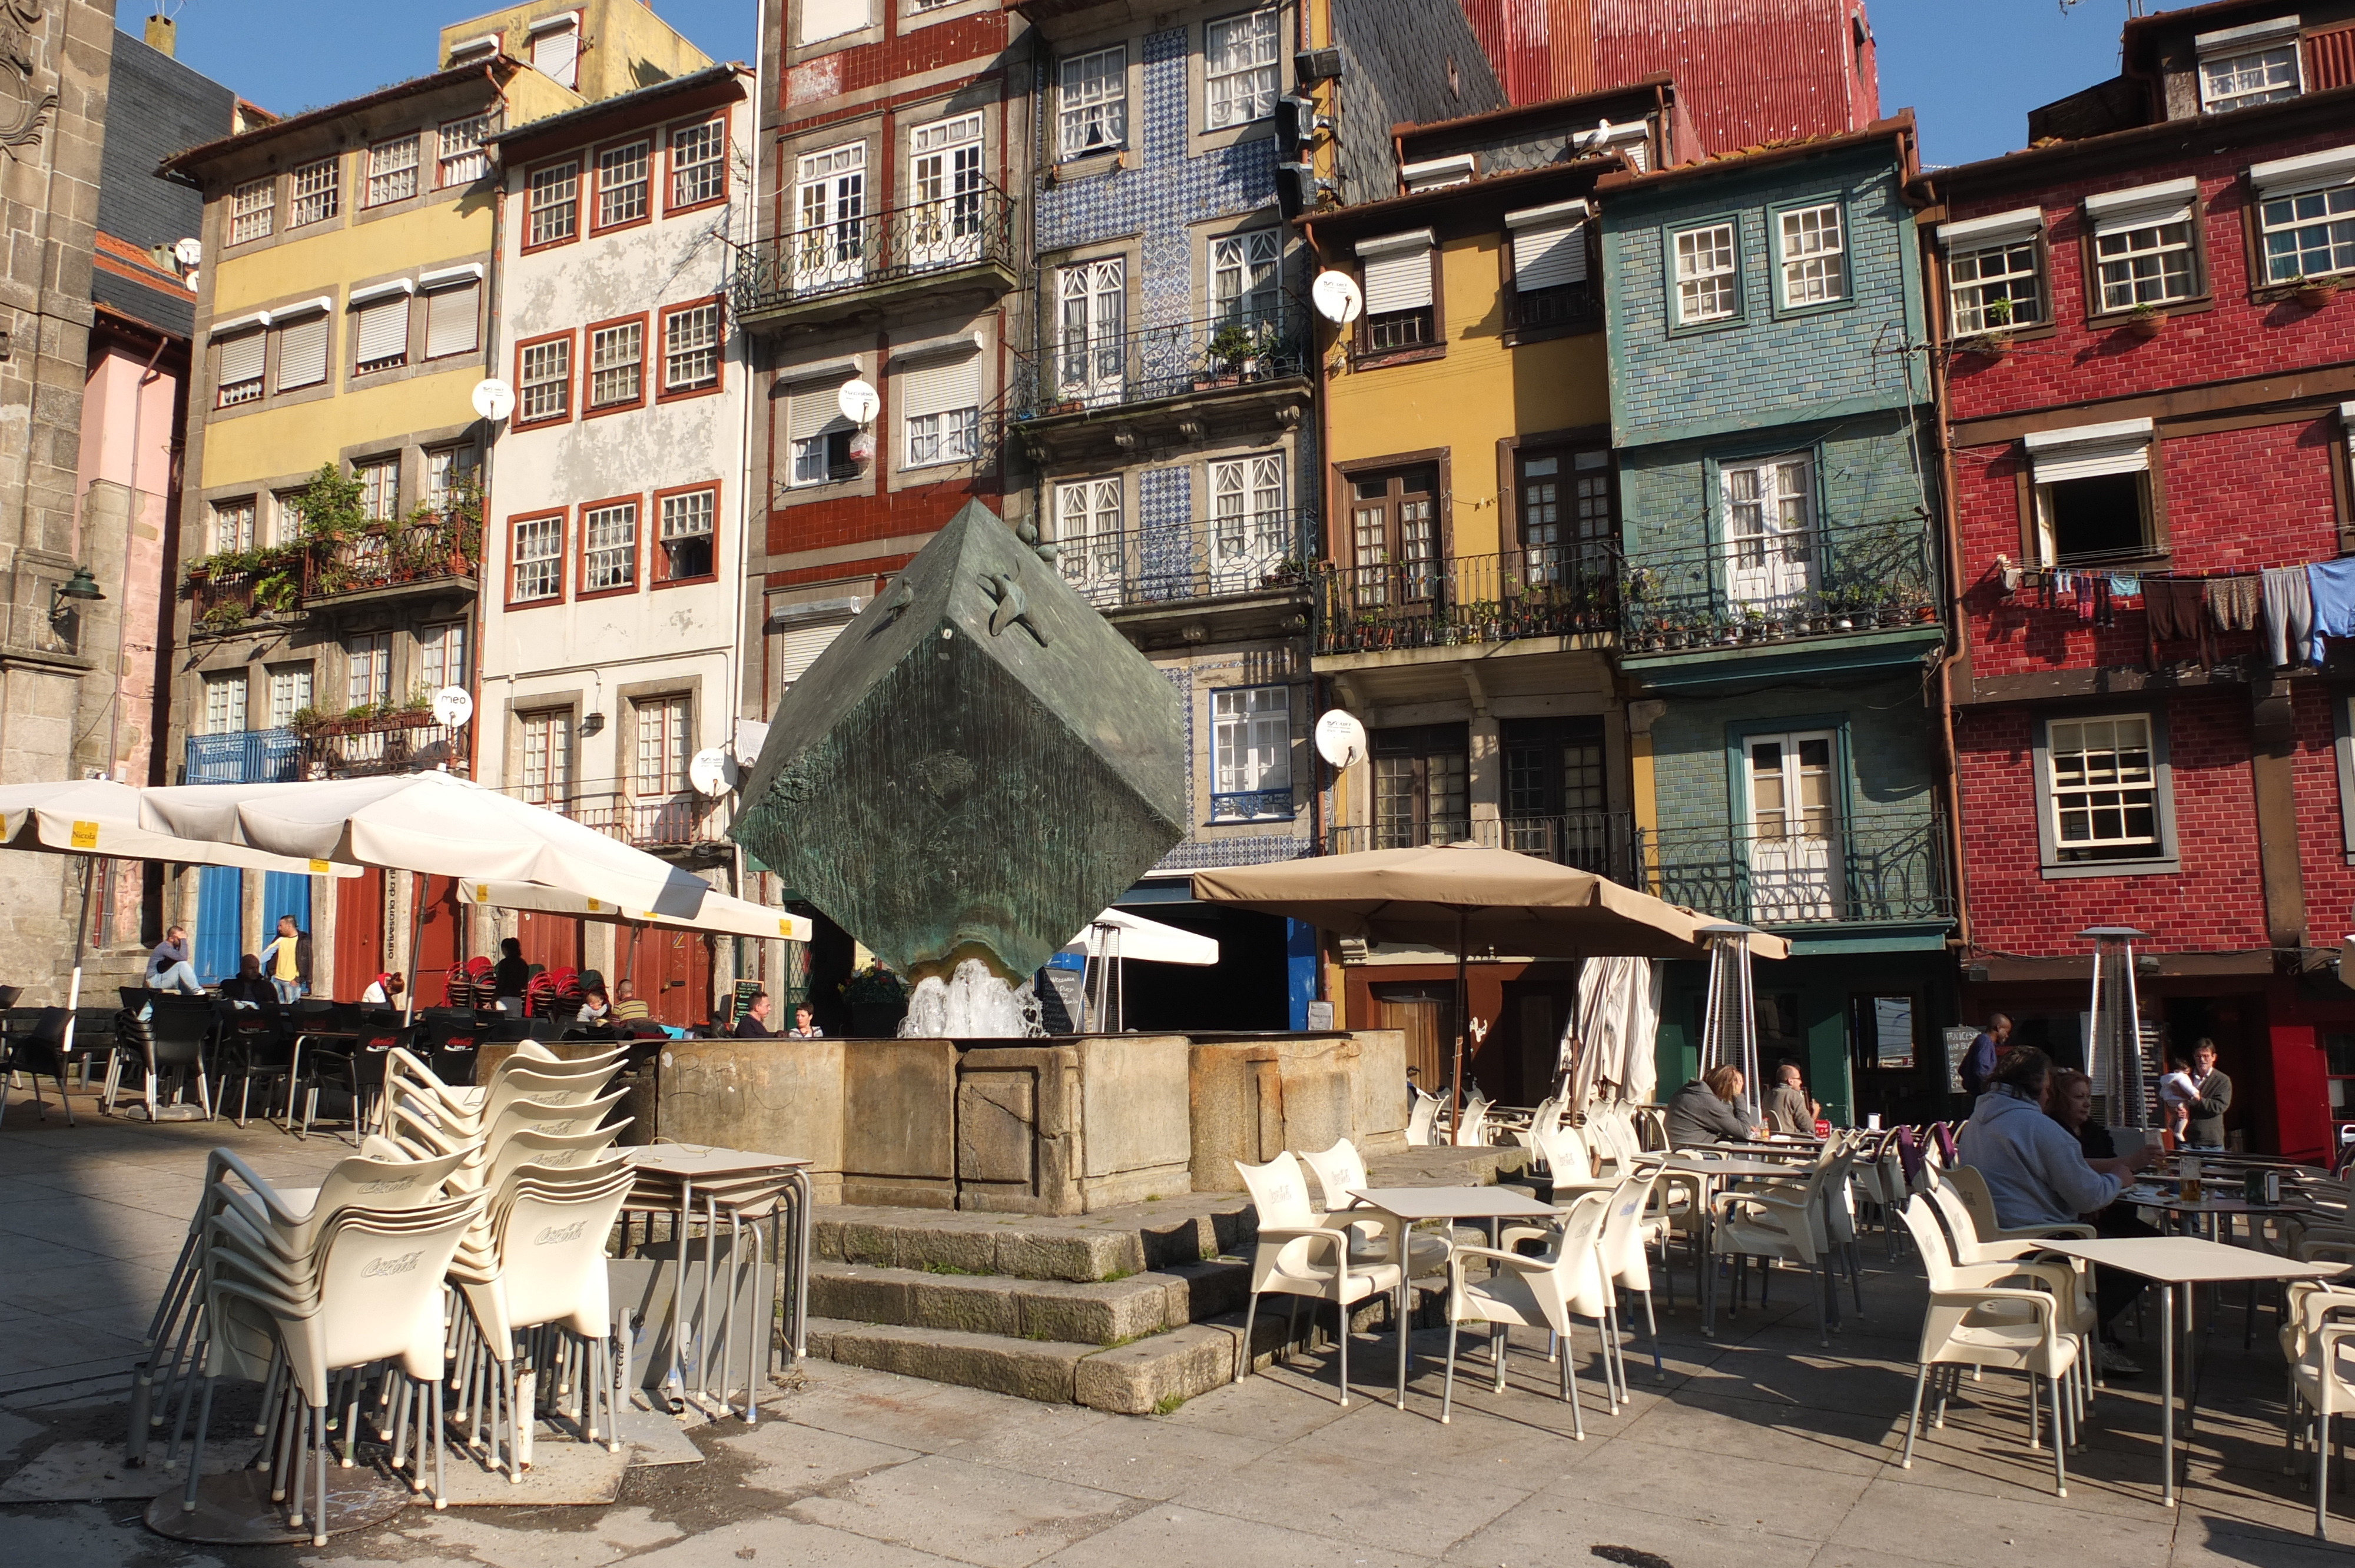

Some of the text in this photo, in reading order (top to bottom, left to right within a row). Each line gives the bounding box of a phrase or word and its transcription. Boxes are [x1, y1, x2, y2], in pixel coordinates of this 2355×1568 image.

[442, 696, 466, 704] meo
[72, 830, 95, 839] Nicola
[388, 882, 396, 896] da
